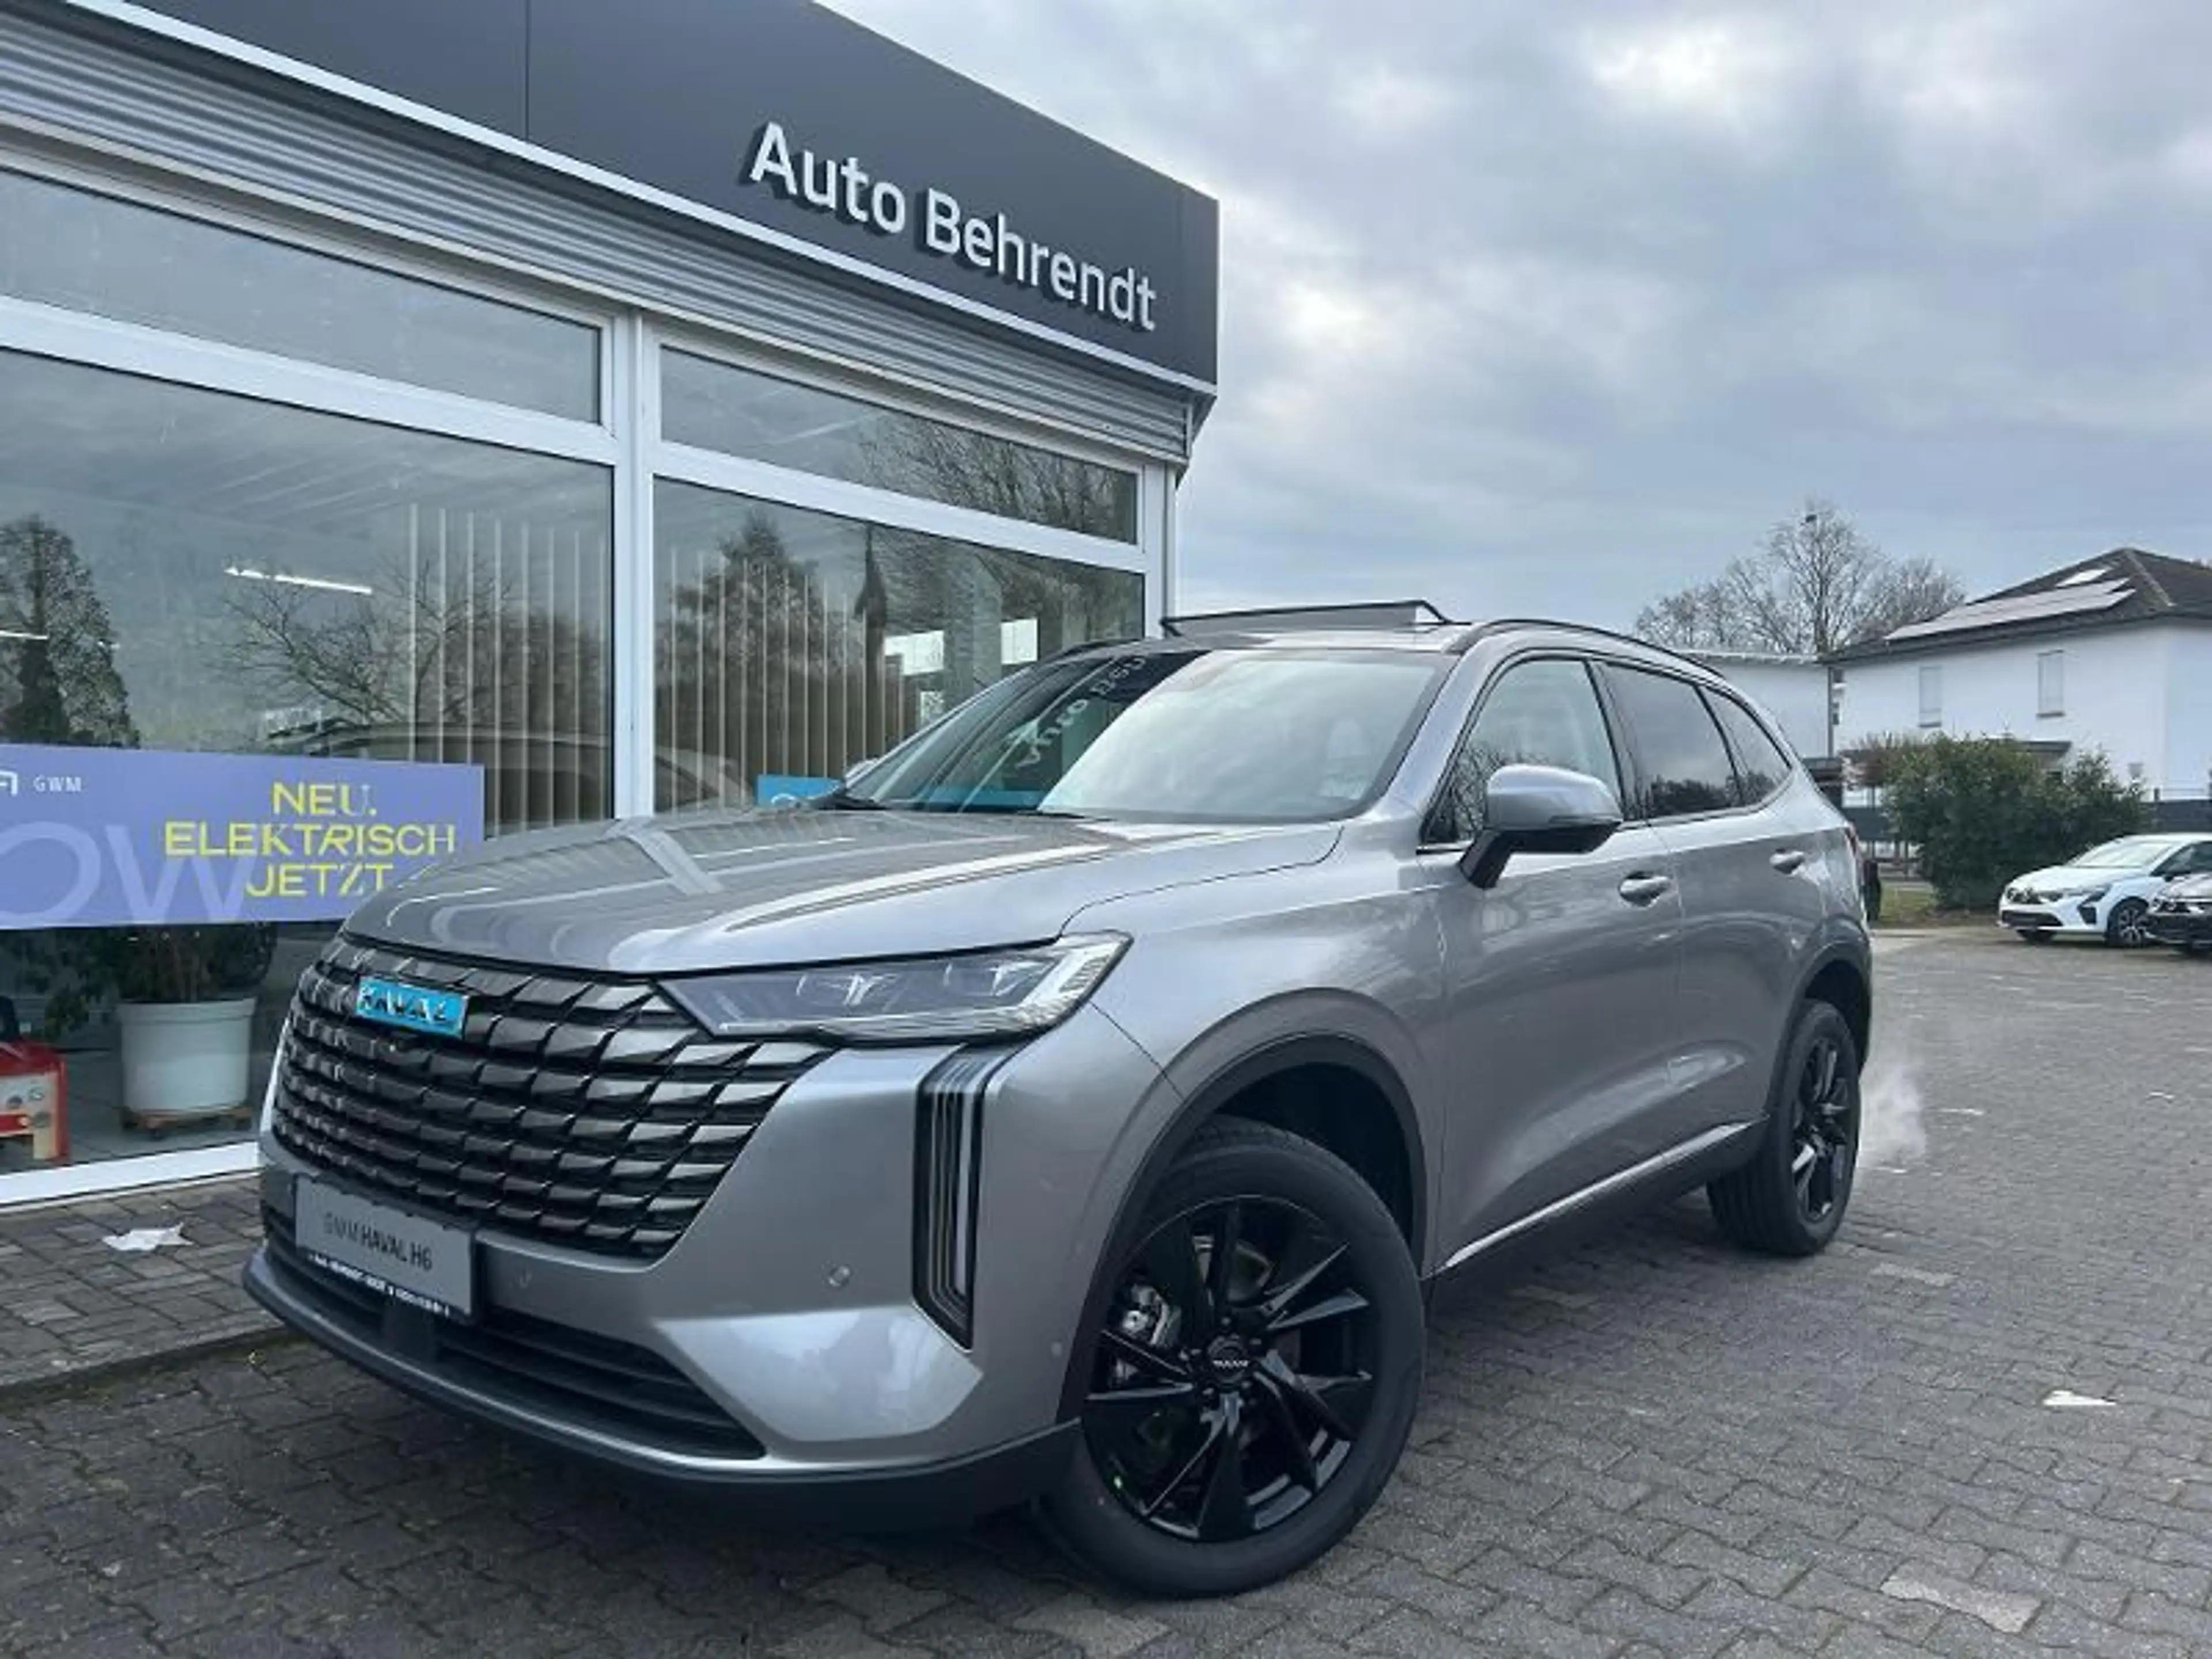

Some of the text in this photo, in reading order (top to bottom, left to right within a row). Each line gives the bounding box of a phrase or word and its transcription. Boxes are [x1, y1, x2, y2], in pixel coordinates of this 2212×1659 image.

[750, 121, 1157, 332] Auto Behrendt
[33, 775, 82, 793] GWM
[272, 782, 377, 816] NEU.
[165, 821, 455, 856] ELEKTRISCH
[245, 862, 394, 896] JETZT
[411, 1242, 433, 1271] H6
